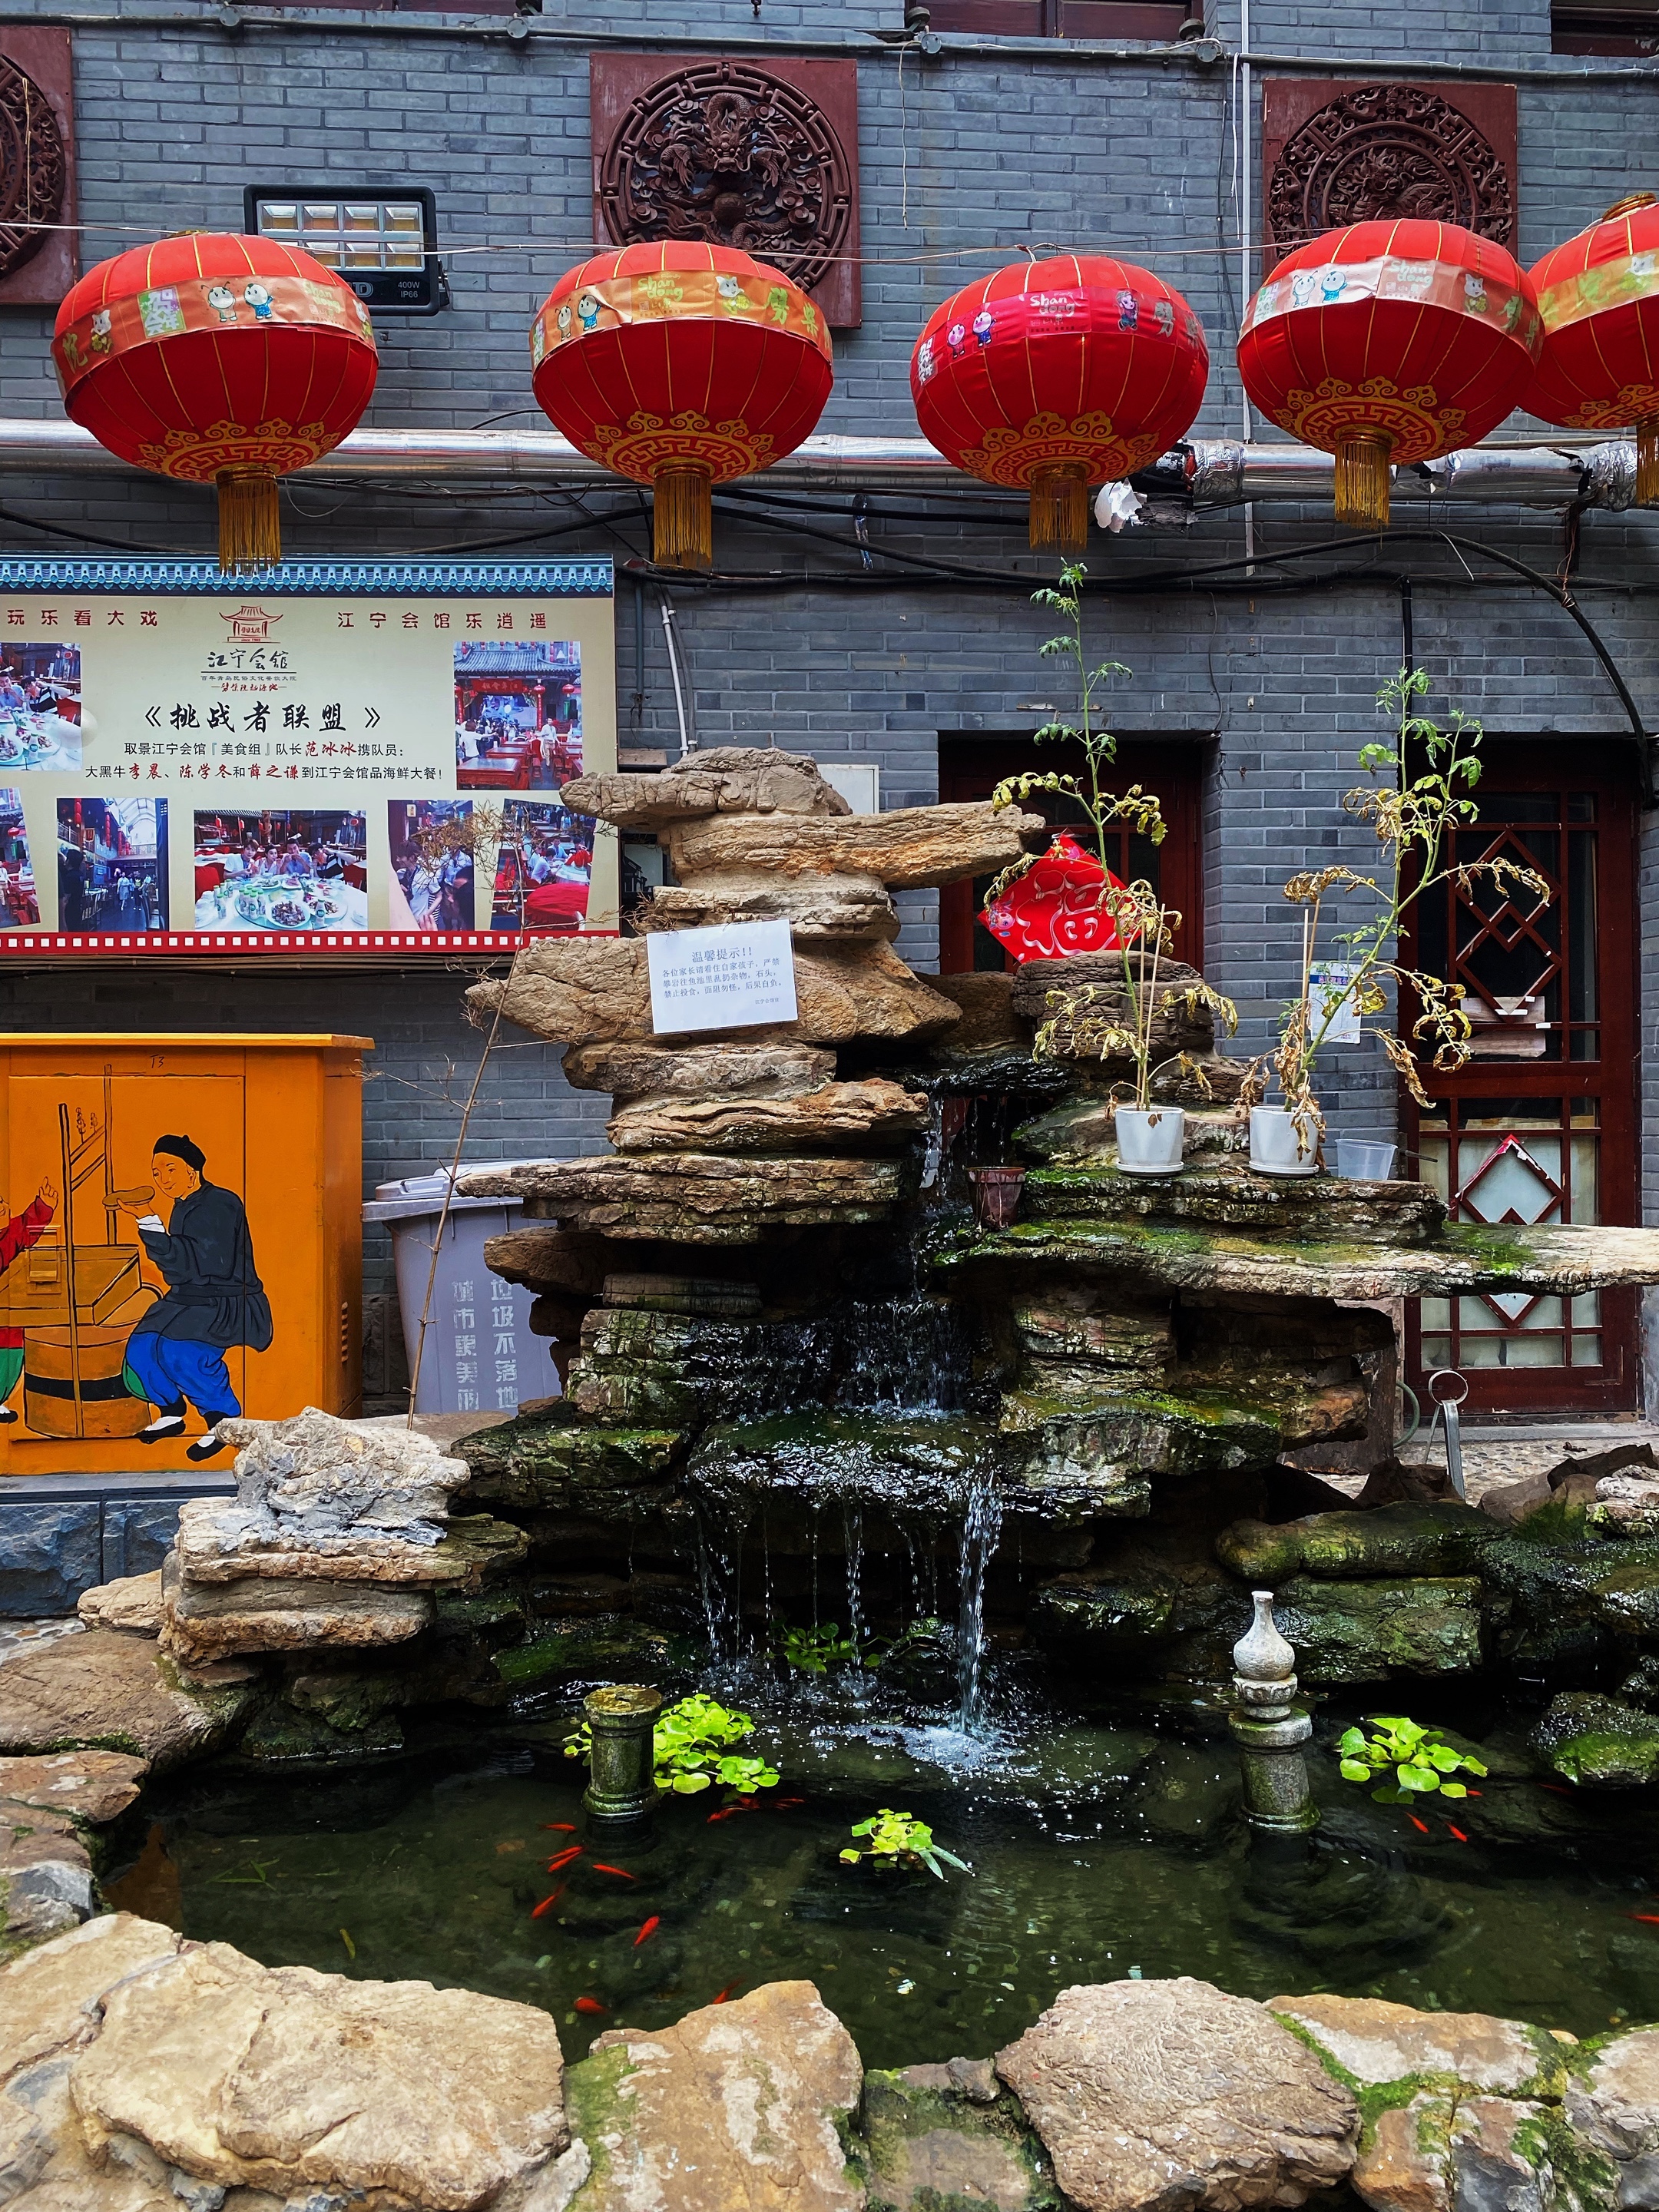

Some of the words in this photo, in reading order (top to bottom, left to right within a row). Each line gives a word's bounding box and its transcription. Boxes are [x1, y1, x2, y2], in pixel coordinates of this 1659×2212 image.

[638, 276, 675, 292] Shan
[647, 286, 684, 303] dong
[1030, 293, 1068, 307] Shan
[1039, 303, 1075, 316] dong
[7, 609, 157, 627] 玩乐看大戏
[337, 611, 547, 629] 江宁会馆乐逍遥
[207, 647, 290, 670] 江宁会馆
[145, 701, 381, 733] 《挑战者联盟》
[1015, 866, 1117, 956] 福
[490, 1279, 518, 1409] 垃圾不落地
